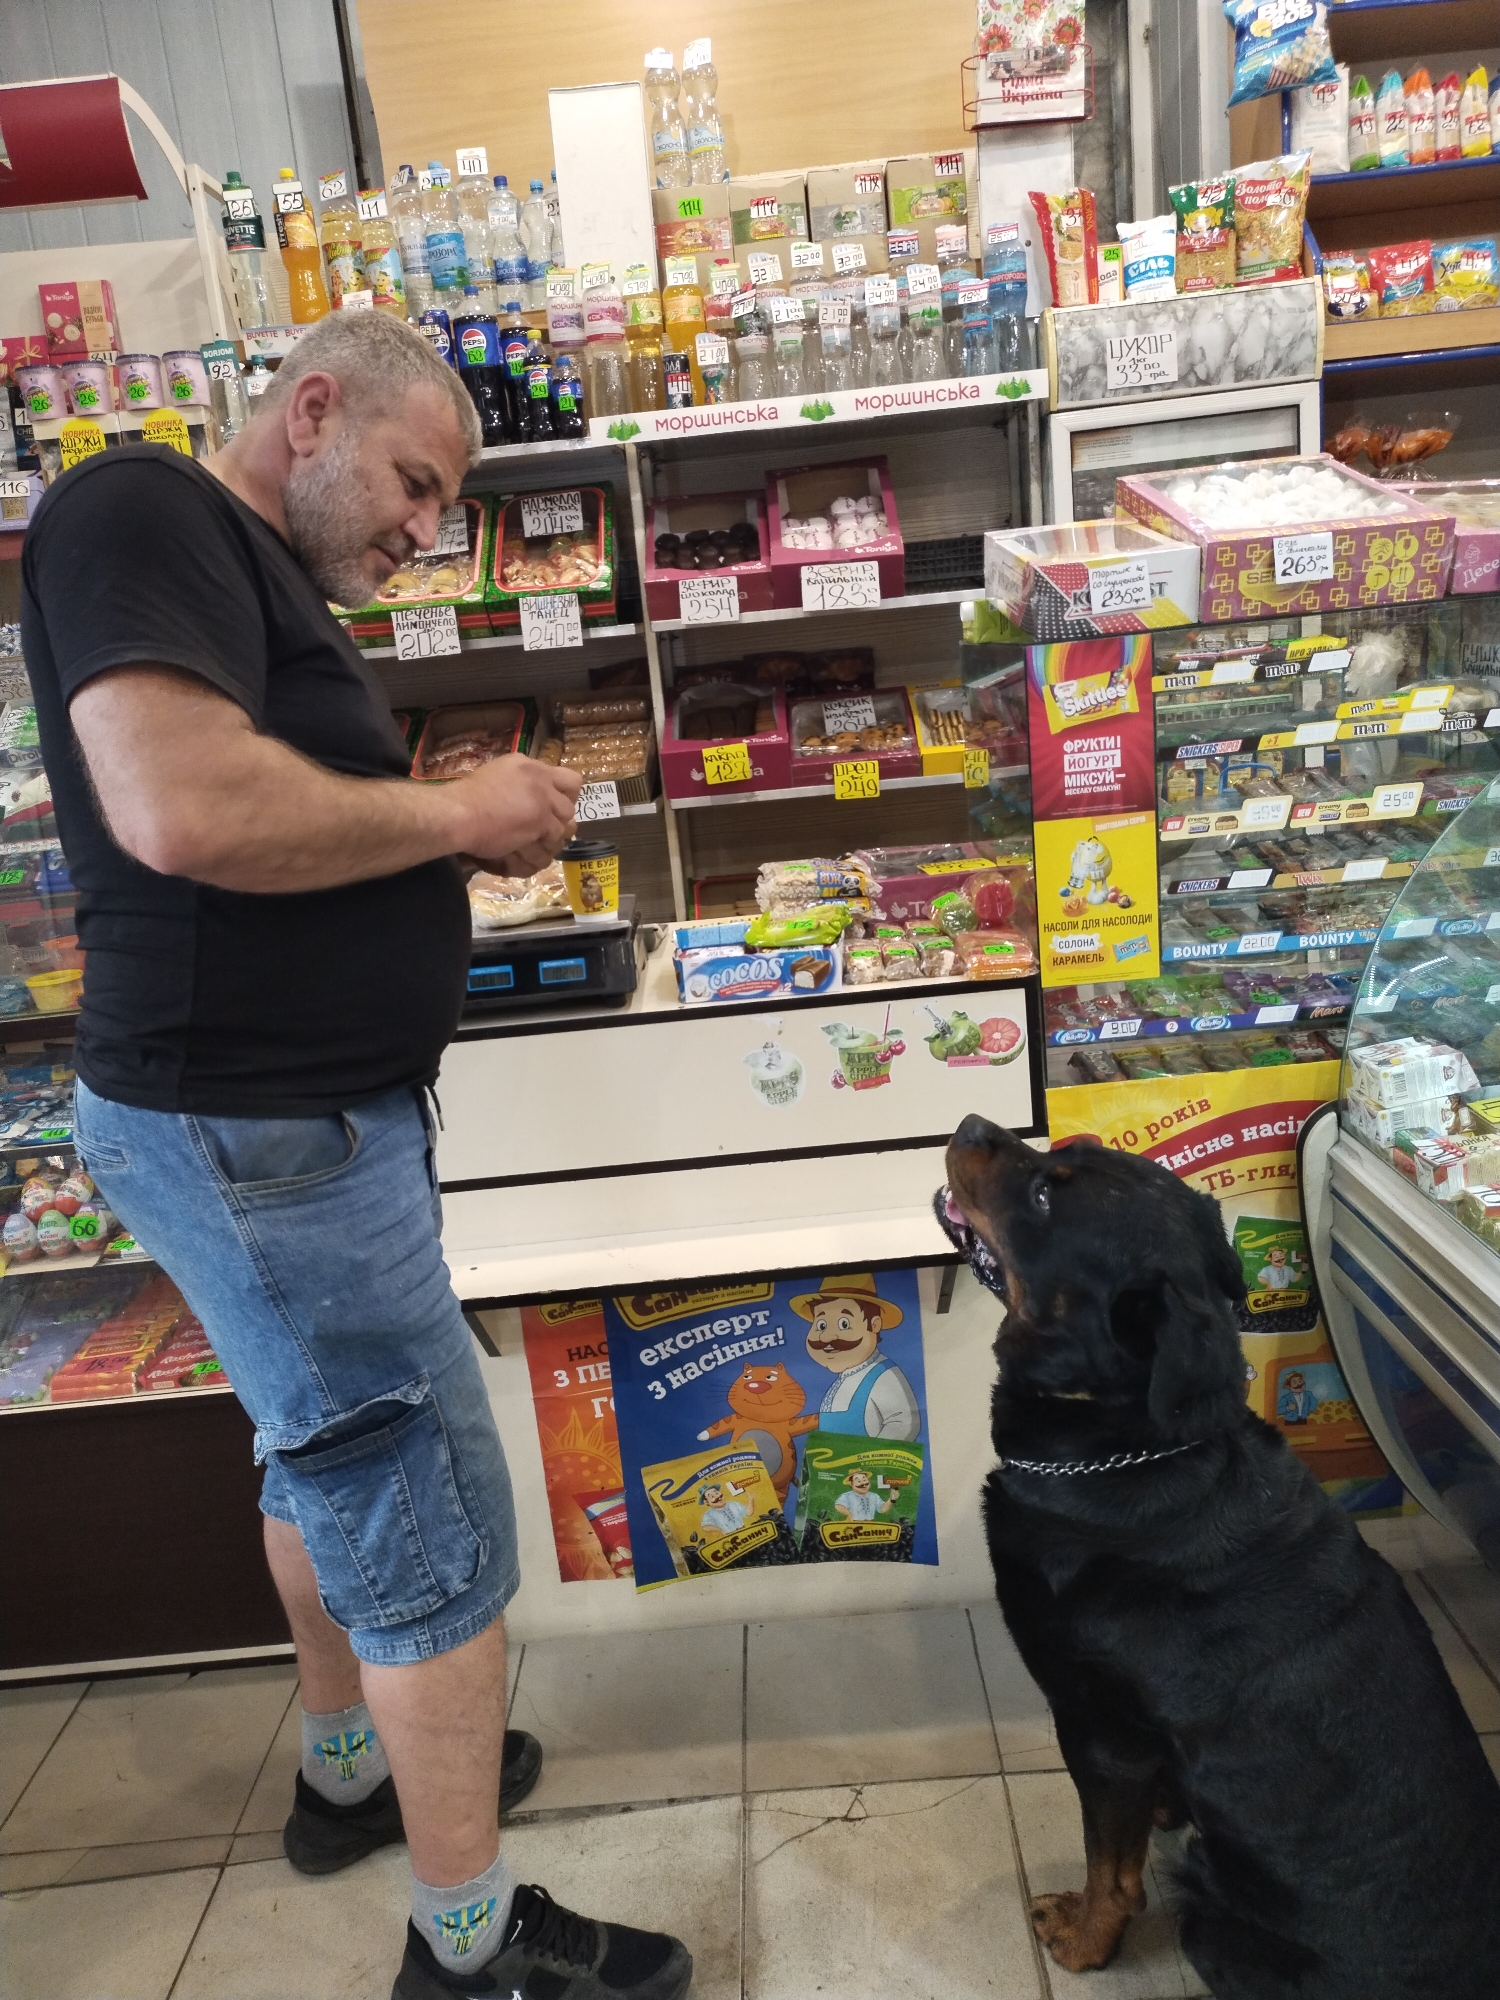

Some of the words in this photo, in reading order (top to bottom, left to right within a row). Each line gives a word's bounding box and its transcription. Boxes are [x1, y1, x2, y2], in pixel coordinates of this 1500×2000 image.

[1272, 4, 1314, 30] BOB
[1245, 39, 1279, 58] попкорн
[1002, 88, 1064, 105] Україна
[322, 181, 345, 199] 62
[231, 201, 252, 218] 26
[282, 193, 303, 210] 55
[679, 201, 701, 216] 114
[247, 330, 278, 340] BUVETTE
[463, 339, 485, 347] PEPSI
[203, 347, 234, 359] BORJOMI
[1109, 333, 1173, 361] ЦУКОР
[506, 352, 527, 360] PEPSI
[212, 363, 233, 380] 92
[1116, 364, 1143, 386] 33
[80, 393, 96, 405] 26
[130, 385, 146, 398] 26
[176, 385, 191, 397] 26
[854, 380, 981, 411] моршинська
[33, 399, 49, 411] 26
[145, 419, 183, 429] НОВИНКА
[655, 403, 780, 433] моршинська
[62, 428, 101, 438] НОВИНКА
[863, 542, 899, 554] Toniya
[739, 562, 768, 572] Toniya
[1281, 556, 1317, 578] 263
[812, 584, 867, 610] 183
[1101, 588, 1133, 608] 235
[529, 610, 570, 621] ТАНЕЦ
[688, 597, 734, 622] 254
[401, 629, 447, 658] 202
[529, 625, 565, 650] 240
[1064, 684, 1128, 717] Skittles
[1063, 736, 1115, 754] ФРУКТИ
[1178, 743, 1219, 759] SNICKERS
[1068, 754, 1117, 770] ЙОГУРТ
[711, 763, 749, 782] 127
[841, 779, 878, 801] 249
[1297, 806, 1311, 818] NEW
[1318, 803, 1341, 813] Creamy
[1166, 820, 1181, 830] NEW
[1187, 815, 1211, 825] Creamy
[580, 861, 594, 870] НЕ
[1178, 879, 1218, 893] SNICKERS
[1294, 873, 1325, 886] Twix
[1043, 920, 1080, 933] НАСОЛИ
[1081, 918, 1101, 932] ДЛЯ
[1102, 913, 1154, 929] НАСОЛОДИ!
[1058, 937, 1096, 950] СОЛОНА
[1299, 932, 1354, 948] BOUNTY
[1052, 953, 1106, 967] КАРАМЕЛЬ
[1173, 943, 1228, 960] BOUNTY
[709, 957, 785, 990] COCOS
[1310, 1005, 1346, 1019] Mars
[1144, 1097, 1212, 1142] років
[1109, 1130, 1140, 1152] 10
[1153, 1132, 1235, 1173] Якісне
[73, 1220, 97, 1237] 66
[639, 1310, 770, 1366] експерт
[647, 1380, 667, 1400] з
[665, 1324, 784, 1390] насіння!
